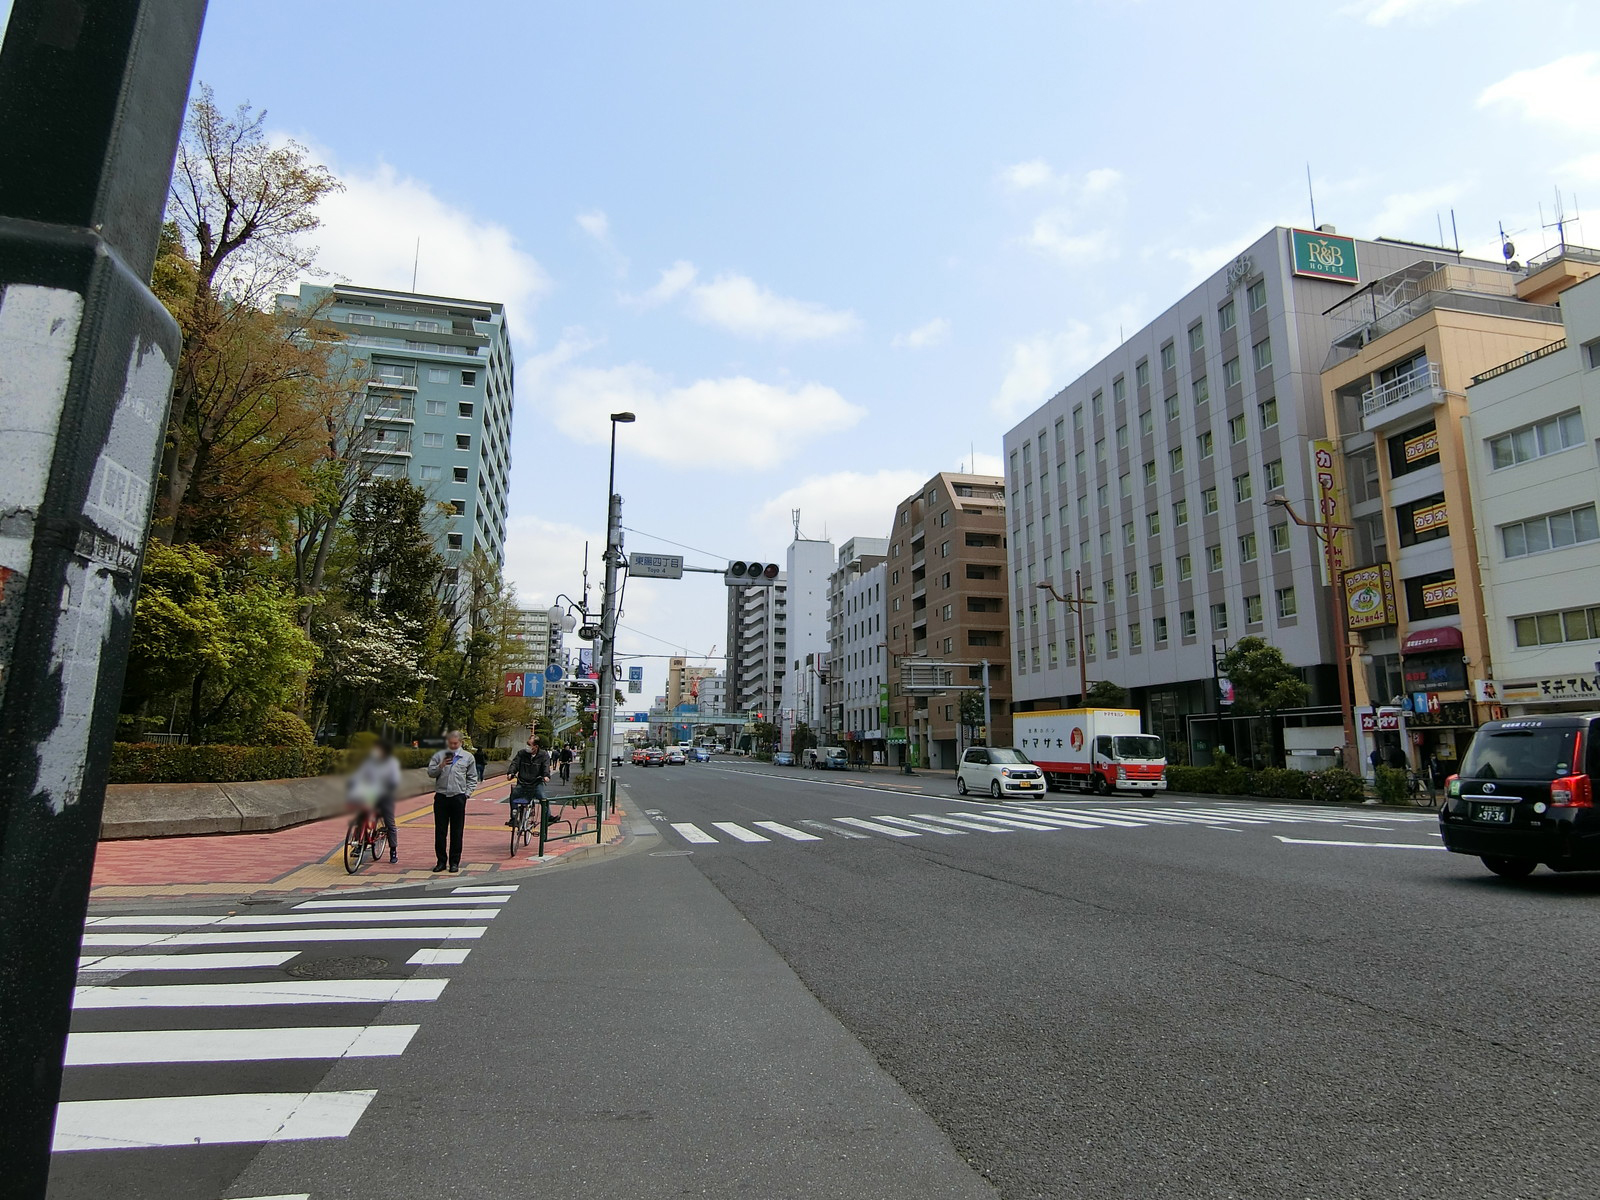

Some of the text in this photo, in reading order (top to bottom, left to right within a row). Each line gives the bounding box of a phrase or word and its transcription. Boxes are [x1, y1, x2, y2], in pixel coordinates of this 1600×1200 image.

[1308, 242, 1344, 266] R&B
[1309, 264, 1344, 274] HOTEL
[1406, 435, 1439, 458] カラオ
[1414, 508, 1447, 528] カラオ
[635, 556, 679, 568] 東陽四丁目
[1346, 571, 1380, 587] カラオケ
[1424, 586, 1458, 602] カラオ
[1363, 716, 1397, 727] カオケ
